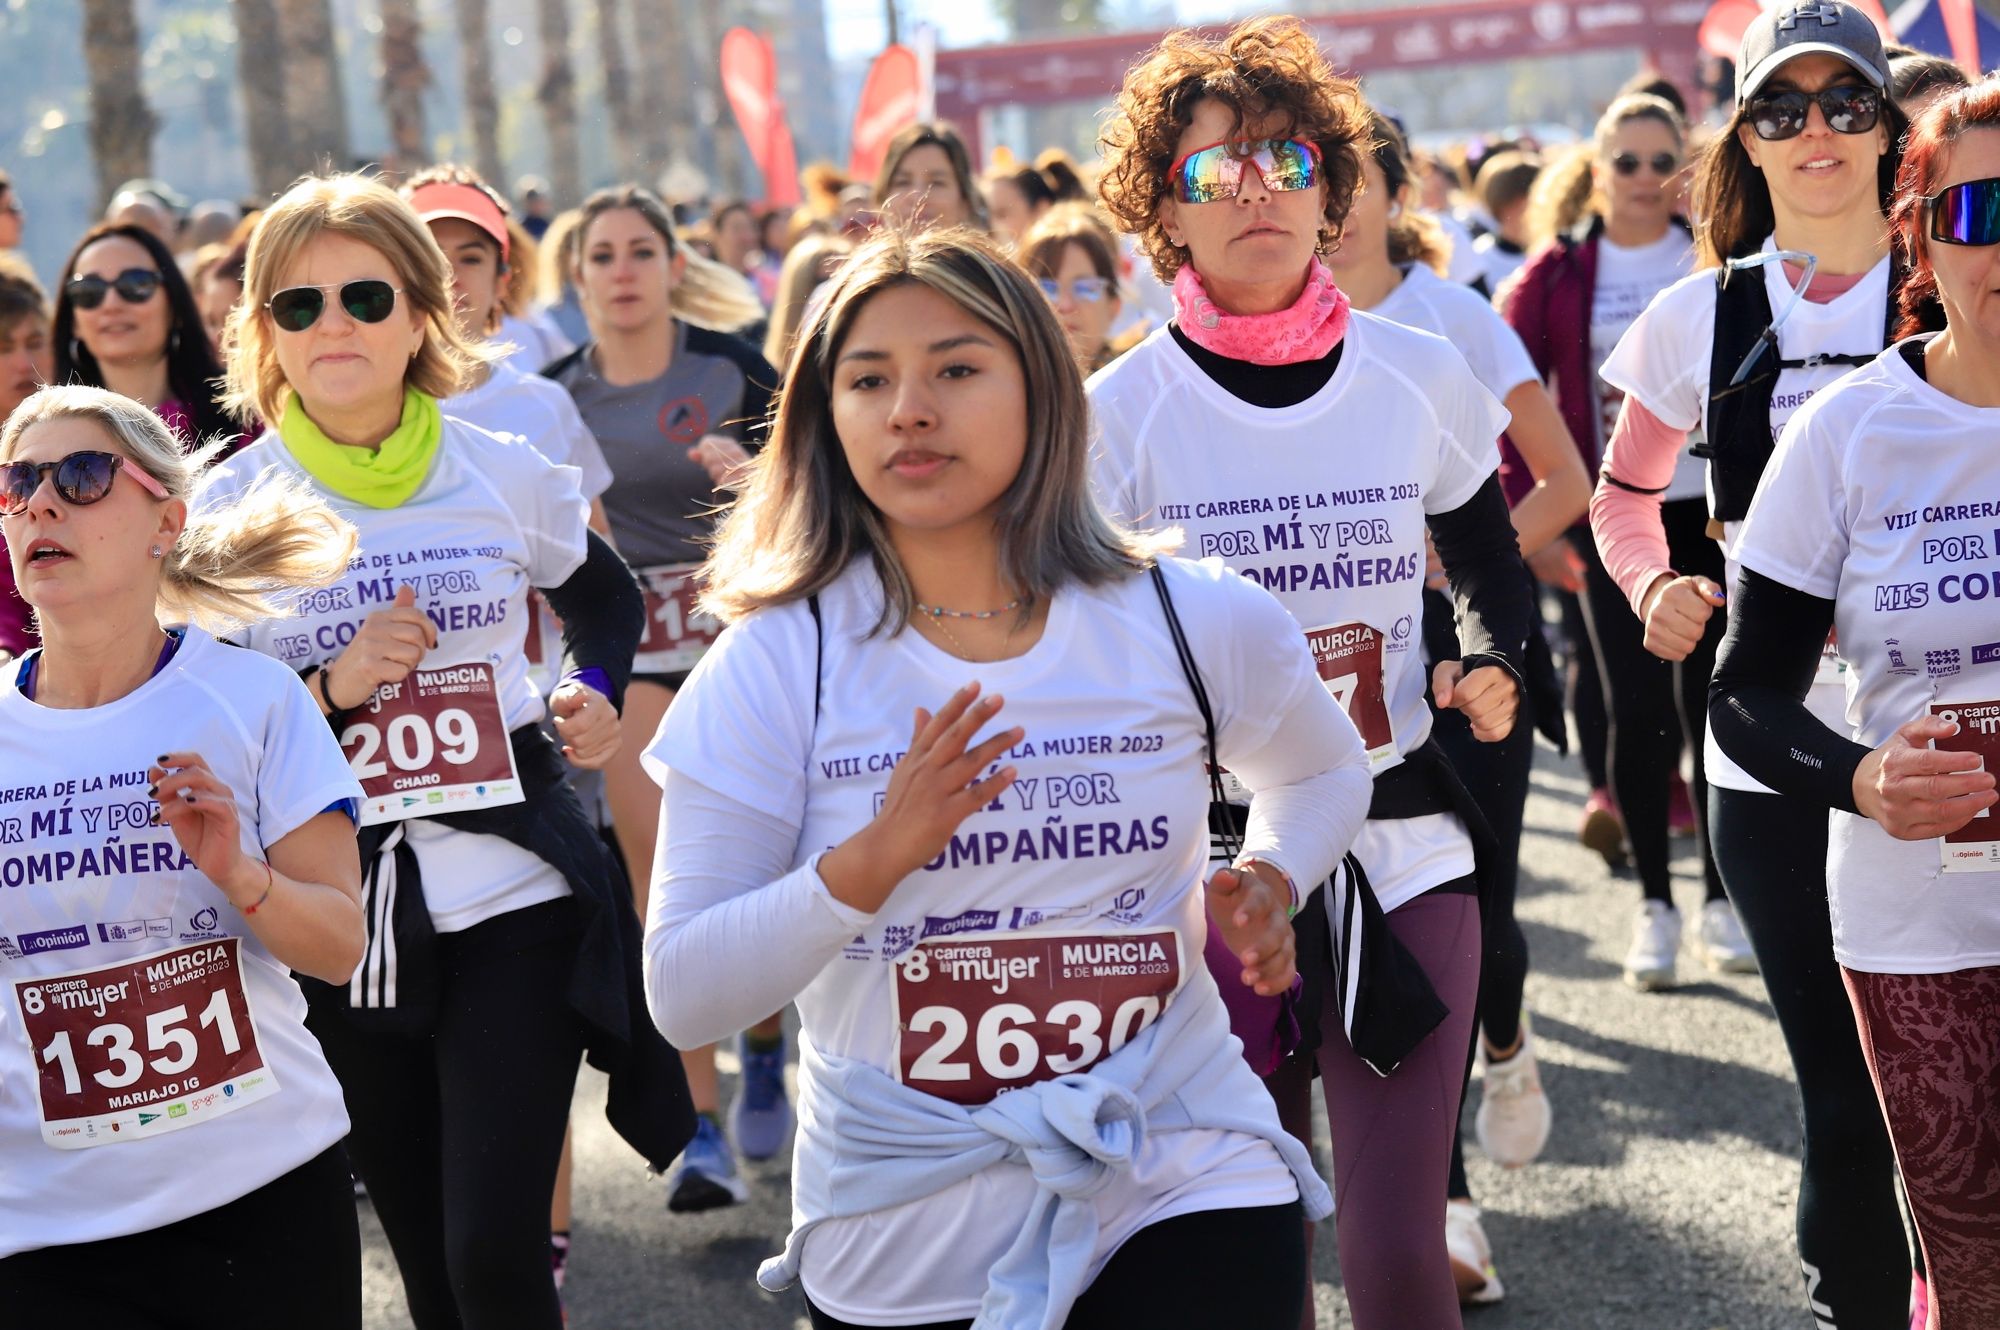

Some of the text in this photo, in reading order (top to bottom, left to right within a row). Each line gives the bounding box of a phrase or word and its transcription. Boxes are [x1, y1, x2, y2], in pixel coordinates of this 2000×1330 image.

[1159, 483, 1420, 520] VIII CARRERA DE LA MUJER 2023
[1201, 512, 1393, 558] POR MÍ Y POR
[1884, 510, 1917, 531] VIII
[372, 554, 392, 568] DE
[397, 551, 418, 564] LA
[422, 548, 470, 563] MUJER
[1923, 535, 1988, 564] POR
[299, 586, 353, 617] POR
[357, 569, 397, 604] MÍ
[427, 570, 480, 597] POR
[1874, 582, 1929, 612] MIS
[274, 634, 312, 660] MIS
[1325, 647, 1354, 662] MARZO
[1355, 642, 1375, 653] 2023
[416, 667, 488, 687] MURCIA
[1928, 664, 1960, 675] Murcia
[419, 684, 490, 696] 5 DE MARZO 2023
[340, 708, 479, 780] 209
[821, 758, 861, 779] VIII
[1010, 742, 1036, 759] LA
[1043, 735, 1112, 760] MUJER
[1119, 734, 1163, 753] 2023
[54, 780, 76, 797] DE
[82, 776, 103, 793] LA
[393, 773, 440, 790] CHARO
[1012, 778, 1039, 811] Y
[1047, 773, 1120, 808] POR
[31, 798, 73, 839] MÍ
[80, 806, 103, 833] Y
[146, 945, 228, 983] MURCIA
[934, 946, 992, 960] carrera
[1062, 941, 1167, 965] MURCIA
[150, 959, 230, 993] 5 DE MARZO 2023
[952, 956, 1040, 995] mujer
[1063, 963, 1170, 978] 5 DE MARZO 2023
[45, 979, 88, 994] carrera
[61, 980, 129, 1018] mujer
[42, 988, 241, 1095] 1351
[108, 1077, 200, 1109] MARIAJO IG
